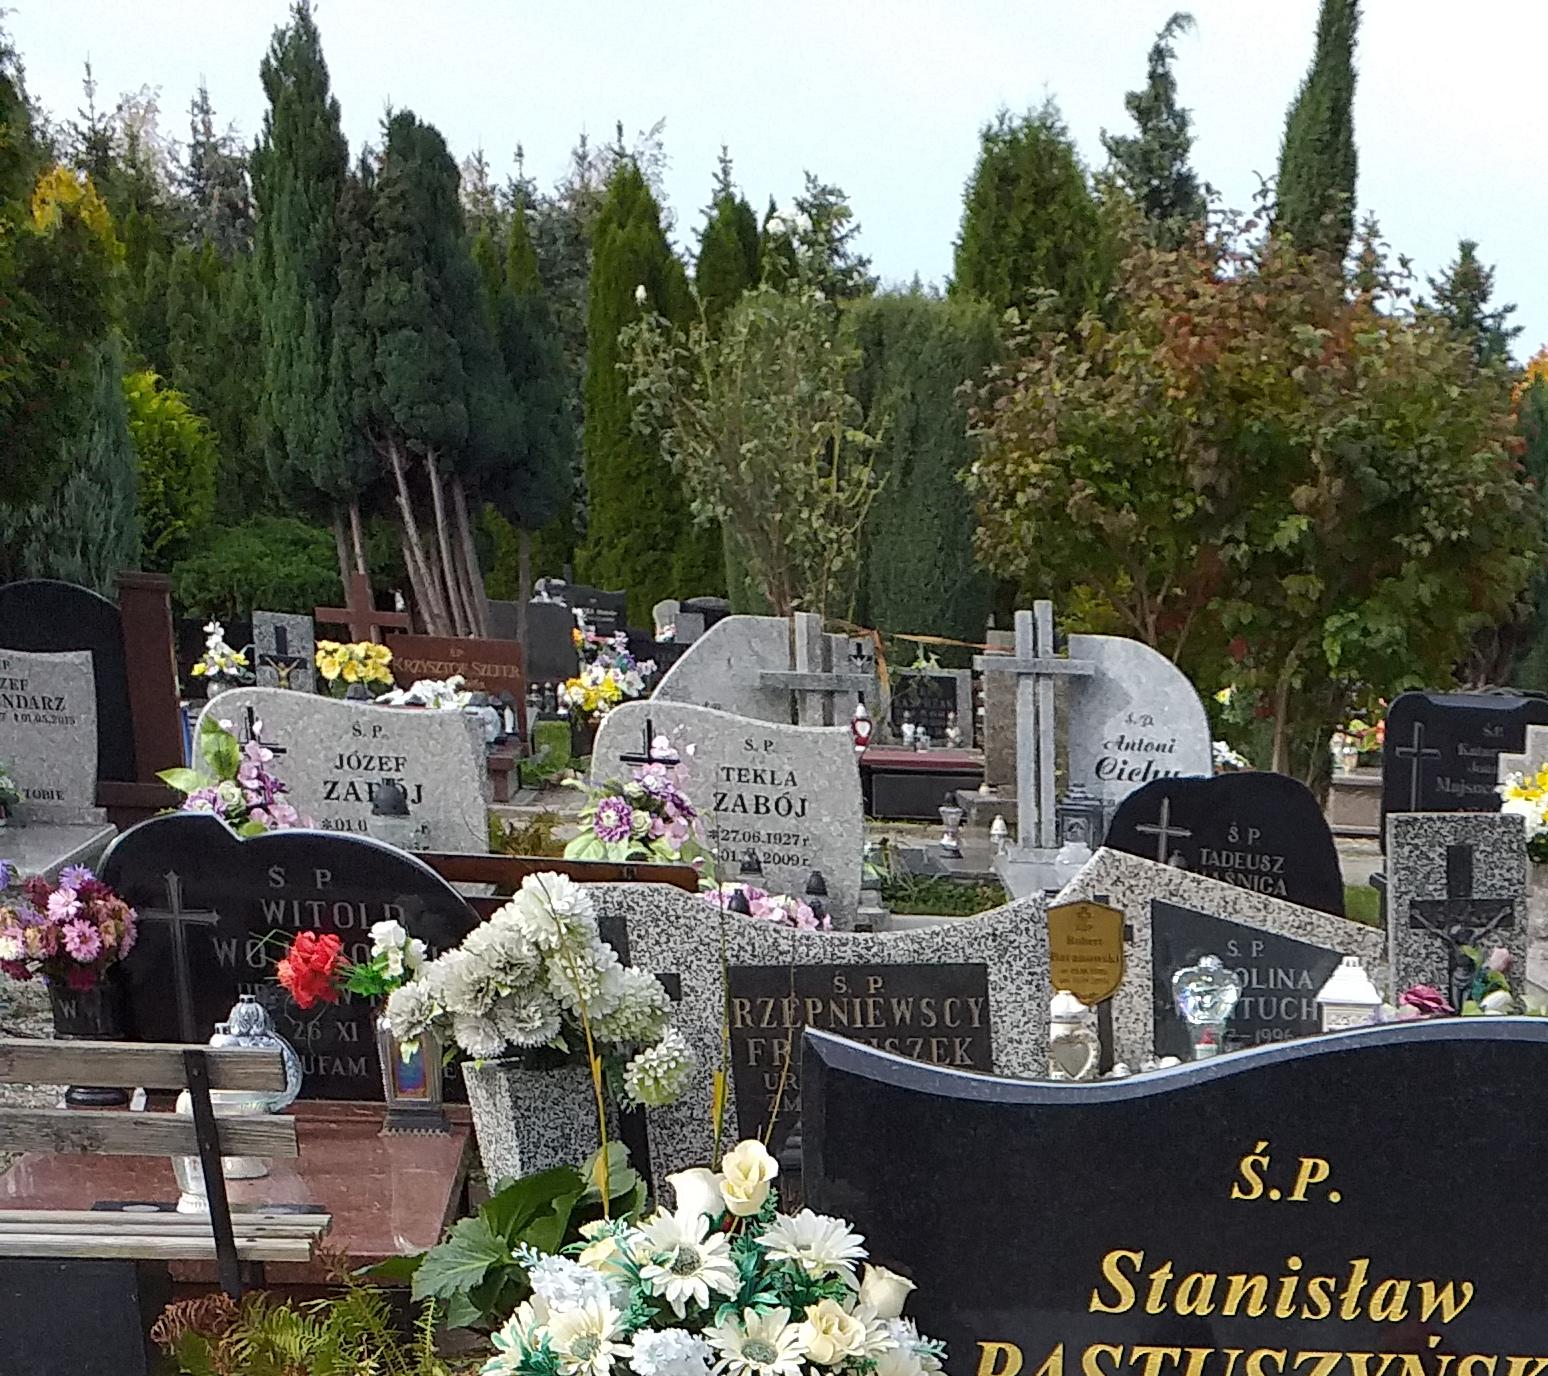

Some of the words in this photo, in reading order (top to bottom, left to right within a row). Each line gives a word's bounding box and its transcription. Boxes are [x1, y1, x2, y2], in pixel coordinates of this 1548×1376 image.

[1103, 734, 1177, 754] Antoni
[334, 750, 408, 773] JÓZEF
[720, 766, 799, 787] TEKLA
[712, 791, 808, 818] ZABÓJ
[1199, 848, 1286, 874] TADEUSZ
[260, 898, 405, 930] WITOLD
[301, 1055, 368, 1076] UFAM
[1231, 1141, 1342, 1204] Ś.P.
[1088, 1249, 1476, 1325] Stanisław
